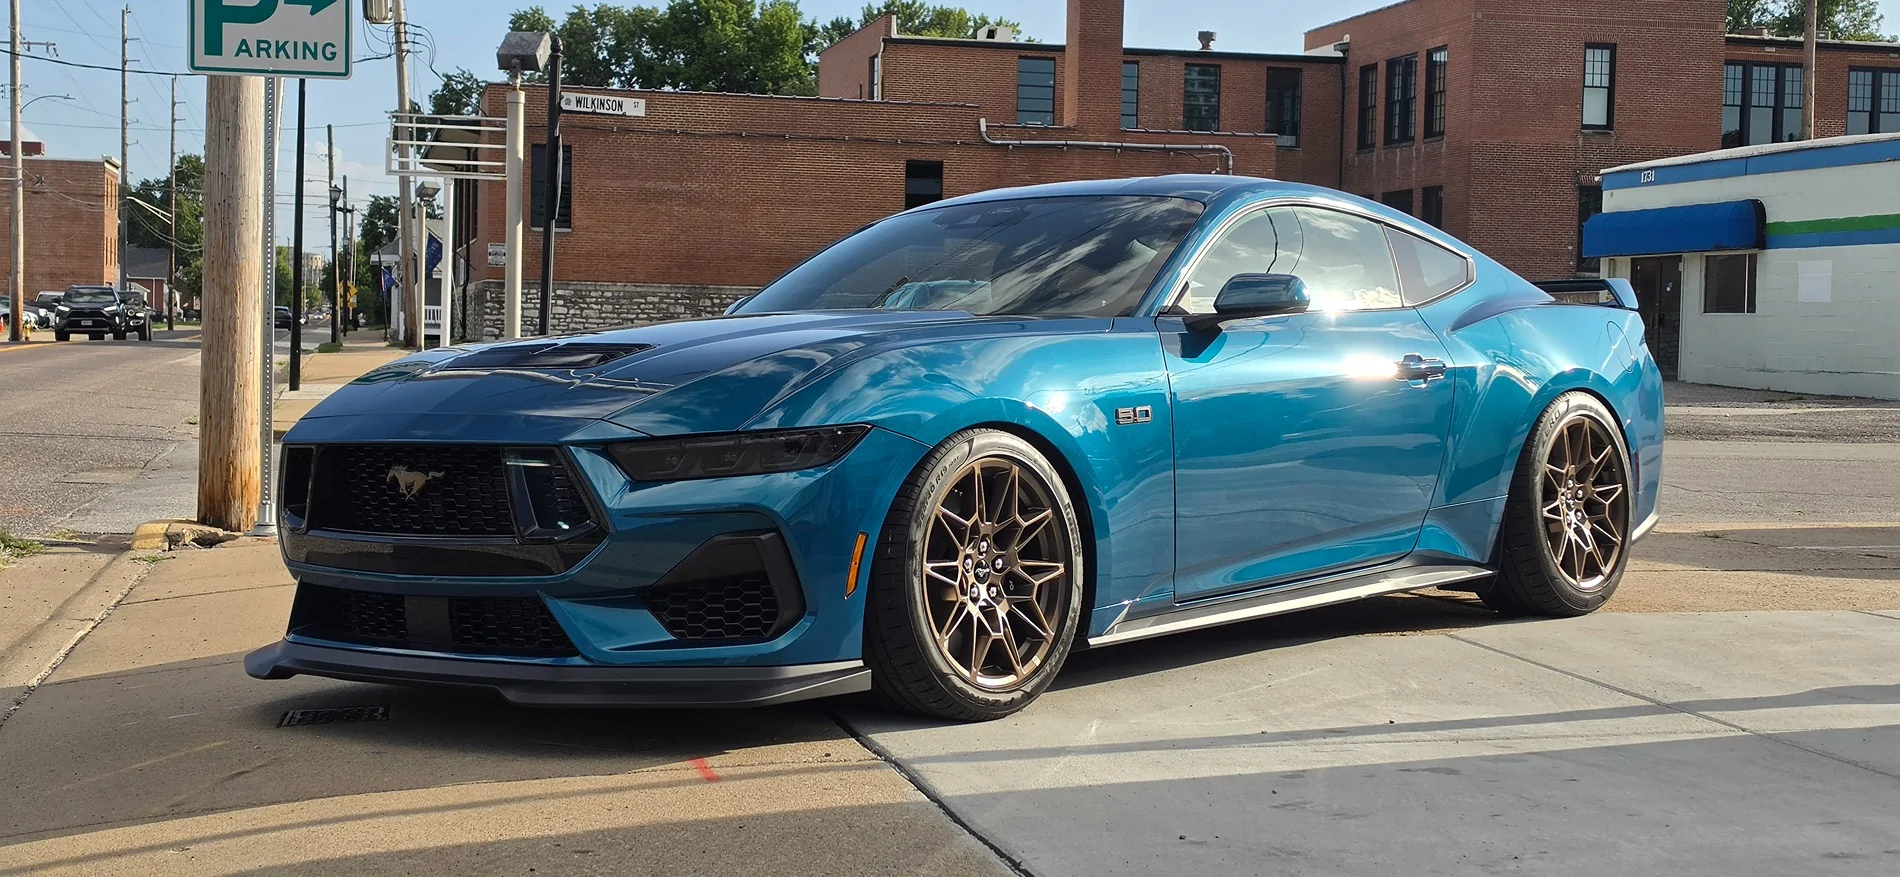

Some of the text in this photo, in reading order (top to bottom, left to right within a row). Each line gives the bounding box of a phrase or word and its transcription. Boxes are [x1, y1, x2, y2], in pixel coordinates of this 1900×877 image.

[575, 96, 640, 112] WILKINSON ST
[1640, 169, 1655, 183] 1731
[1115, 406, 1152, 426] 5.0
